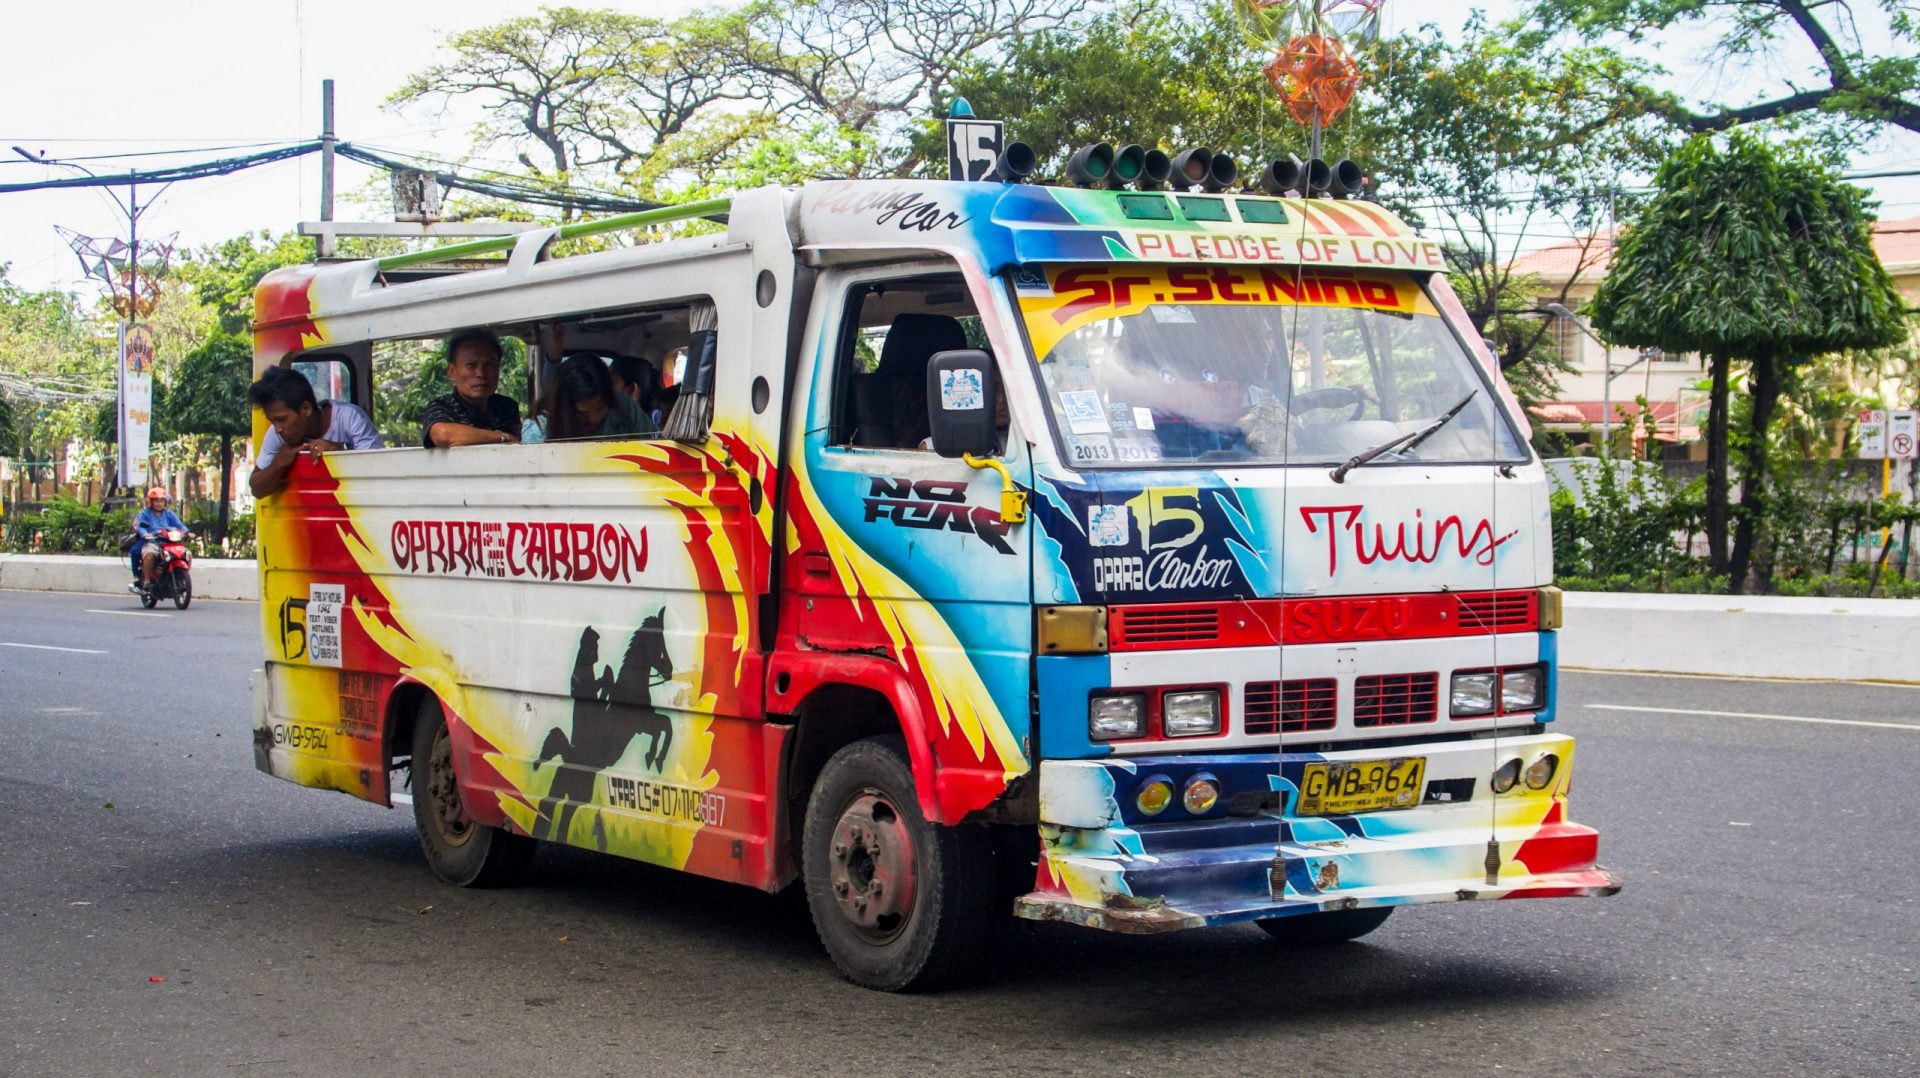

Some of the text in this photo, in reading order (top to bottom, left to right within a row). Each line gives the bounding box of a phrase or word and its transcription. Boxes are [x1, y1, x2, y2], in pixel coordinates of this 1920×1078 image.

[953, 123, 997, 181] 15
[899, 201, 976, 232] Car
[1135, 233, 1443, 266] PLEDGE OF LOVE
[1075, 446, 1109, 459] 2013
[1120, 446, 1161, 460] 2015
[869, 476, 968, 503] NO
[862, 498, 1017, 555] FEAR
[1124, 486, 1205, 555] 15
[1299, 504, 1519, 577] Twins
[506, 522, 649, 583] CARBON
[1145, 544, 1233, 591] Carbon
[323, 616, 337, 624] VIBER
[1280, 600, 1410, 640] ISUZU
